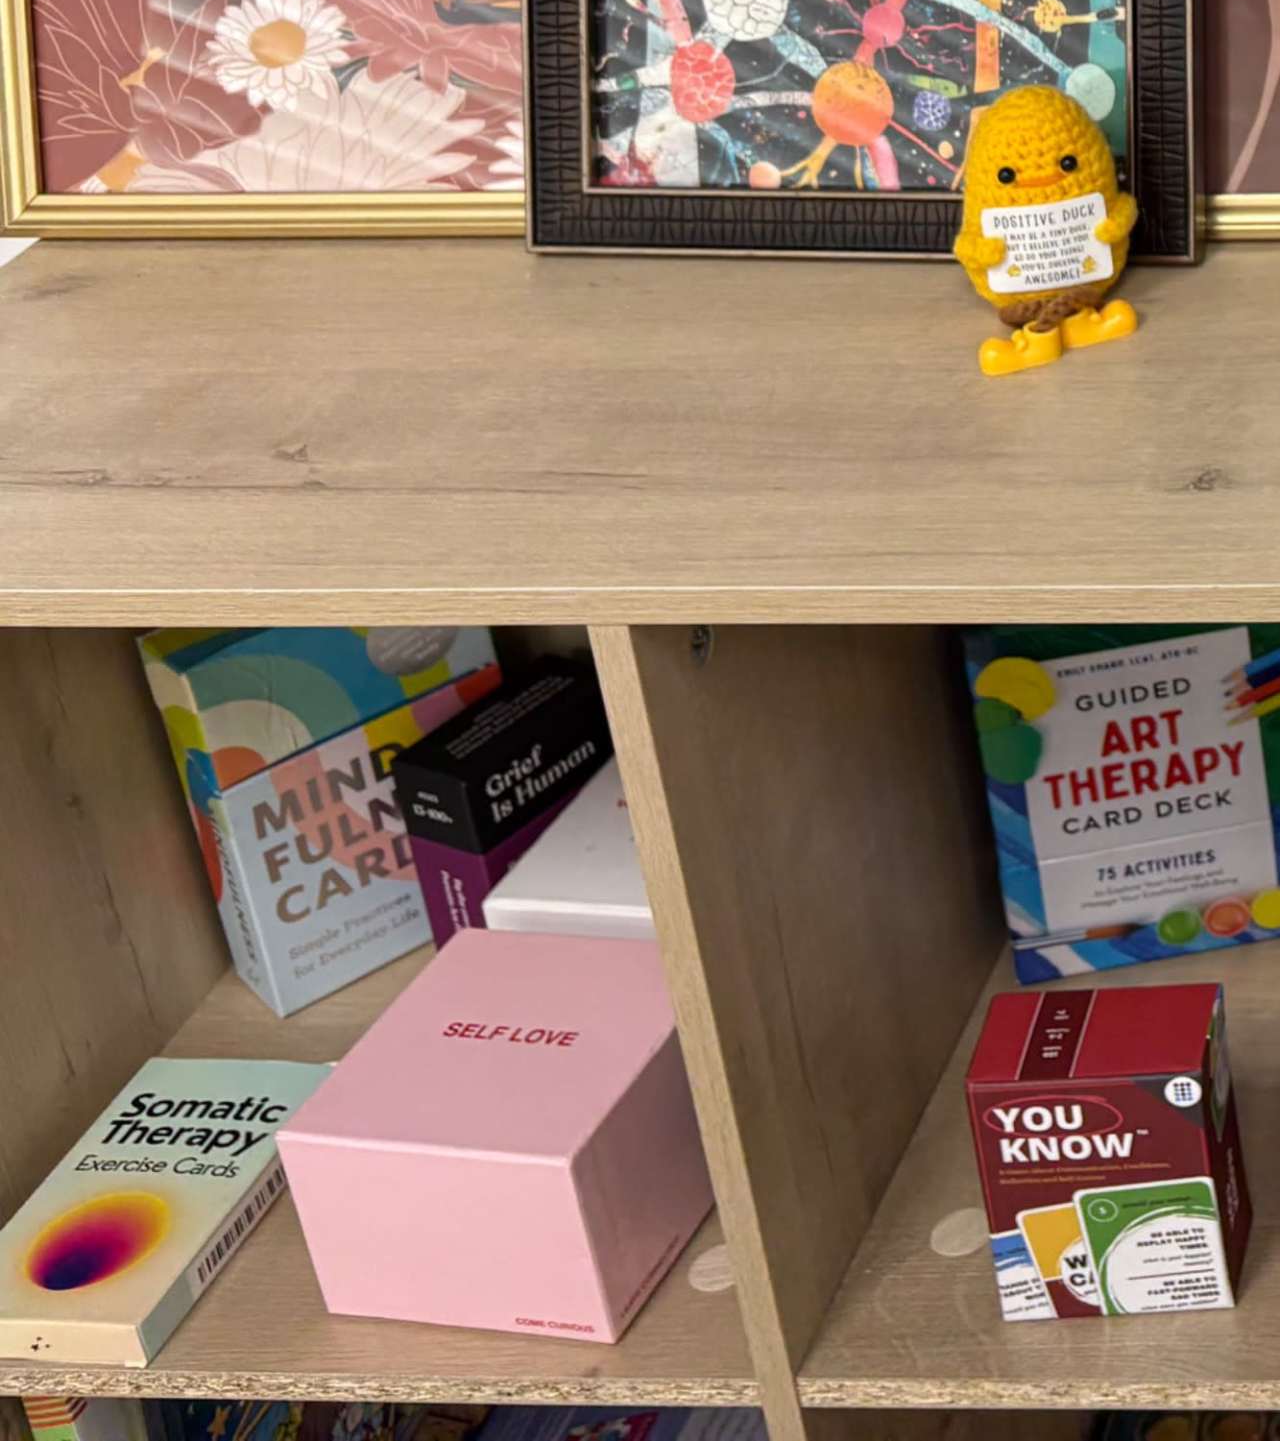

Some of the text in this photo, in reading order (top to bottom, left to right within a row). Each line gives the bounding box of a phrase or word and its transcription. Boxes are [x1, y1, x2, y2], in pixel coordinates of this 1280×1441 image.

[993, 203, 1095, 229] POSITIVE DUCK
[1075, 677, 1191, 713] GUIDED
[1099, 708, 1183, 758] ART
[484, 743, 543, 799] Grief
[490, 740, 596, 823] Is Human
[1043, 740, 1245, 810] THERAPY
[1061, 789, 1233, 836] CARD DECK
[1096, 849, 1217, 882] 75 ACTIVITIES
[289, 926, 340, 960] Simple
[442, 1022, 579, 1047] SELF LOVE
[120, 1093, 288, 1123] Somatic
[992, 1104, 1084, 1133] YOU
[101, 1120, 269, 1157] Therapy
[74, 1154, 240, 1178] Exercise Cards
[1137, 1235, 1206, 1248] REPLAY HAPPY
[515, 1317, 546, 1328] COME
